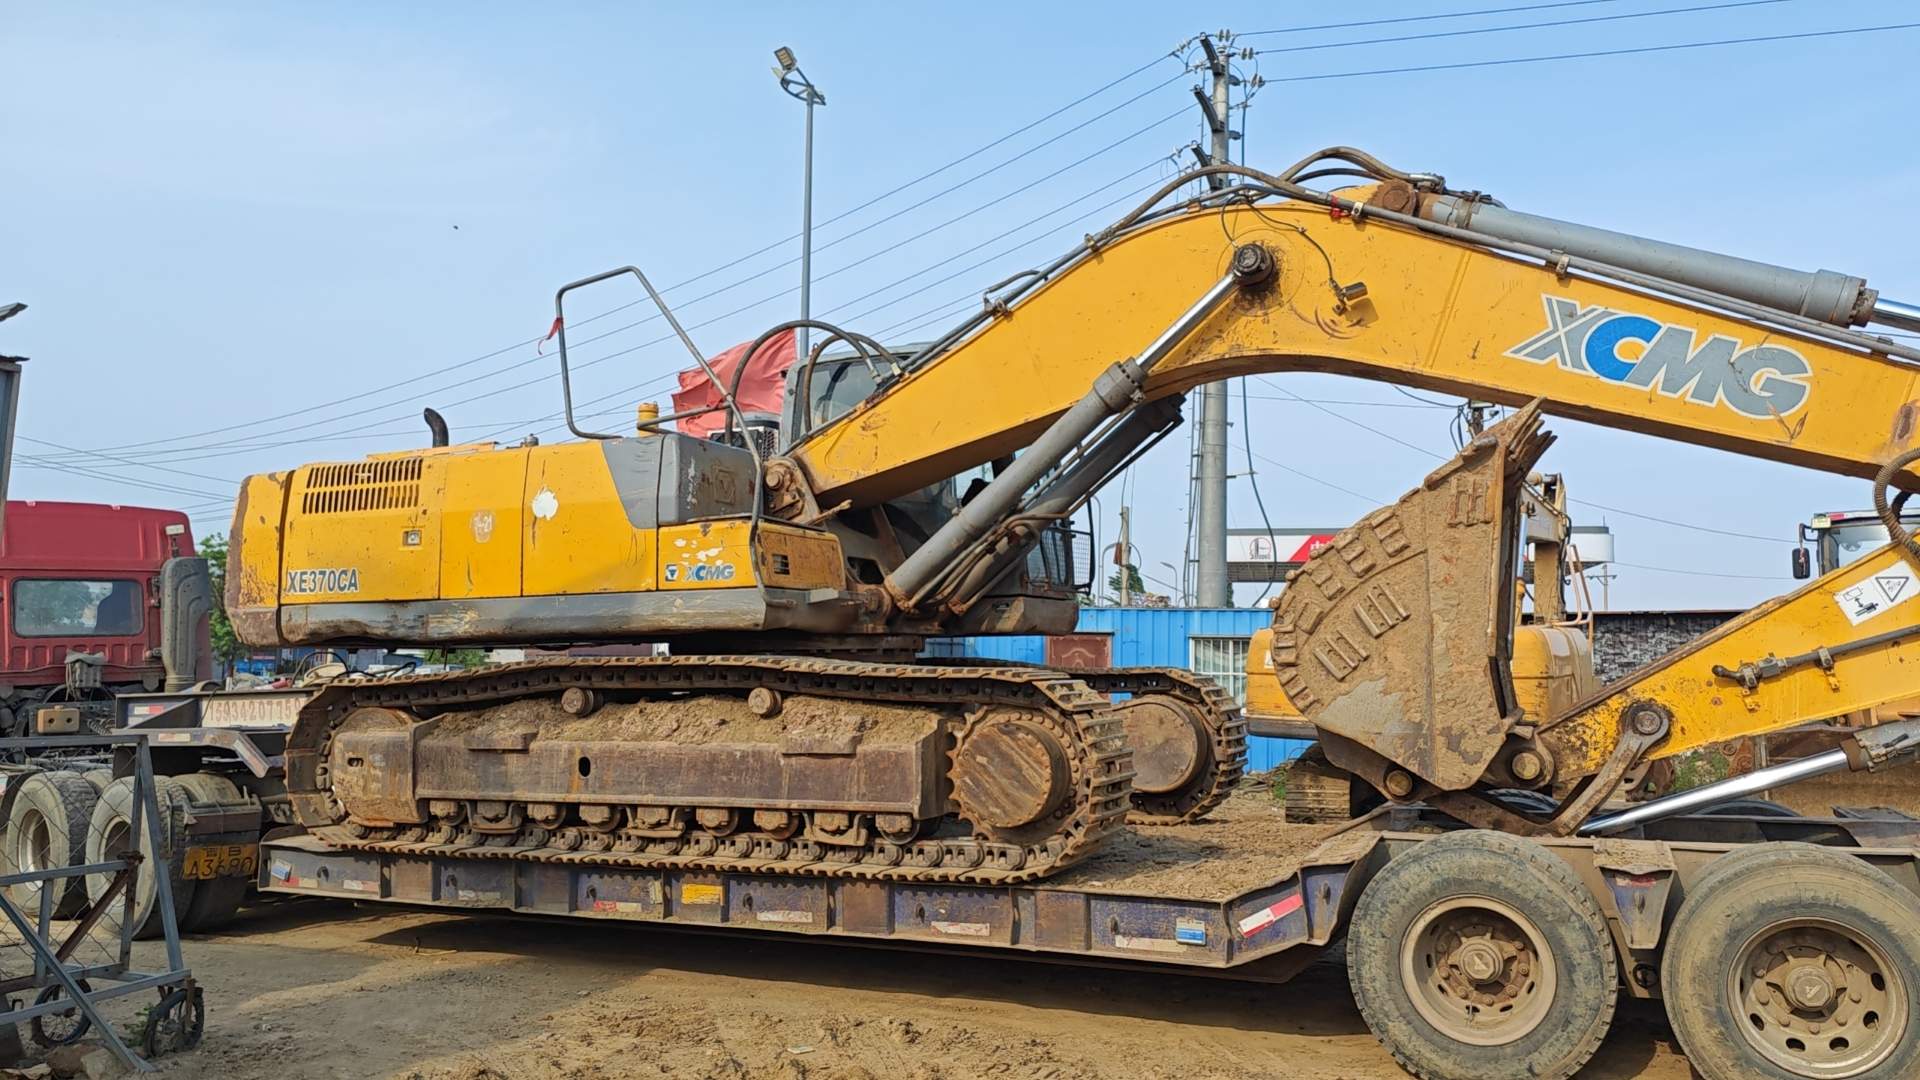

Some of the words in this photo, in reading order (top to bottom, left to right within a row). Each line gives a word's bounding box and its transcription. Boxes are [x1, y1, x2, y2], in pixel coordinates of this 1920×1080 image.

[1503, 294, 1813, 419] XCMG
[287, 567, 359, 593] XE370CA
[685, 563, 735, 581] XCMG
